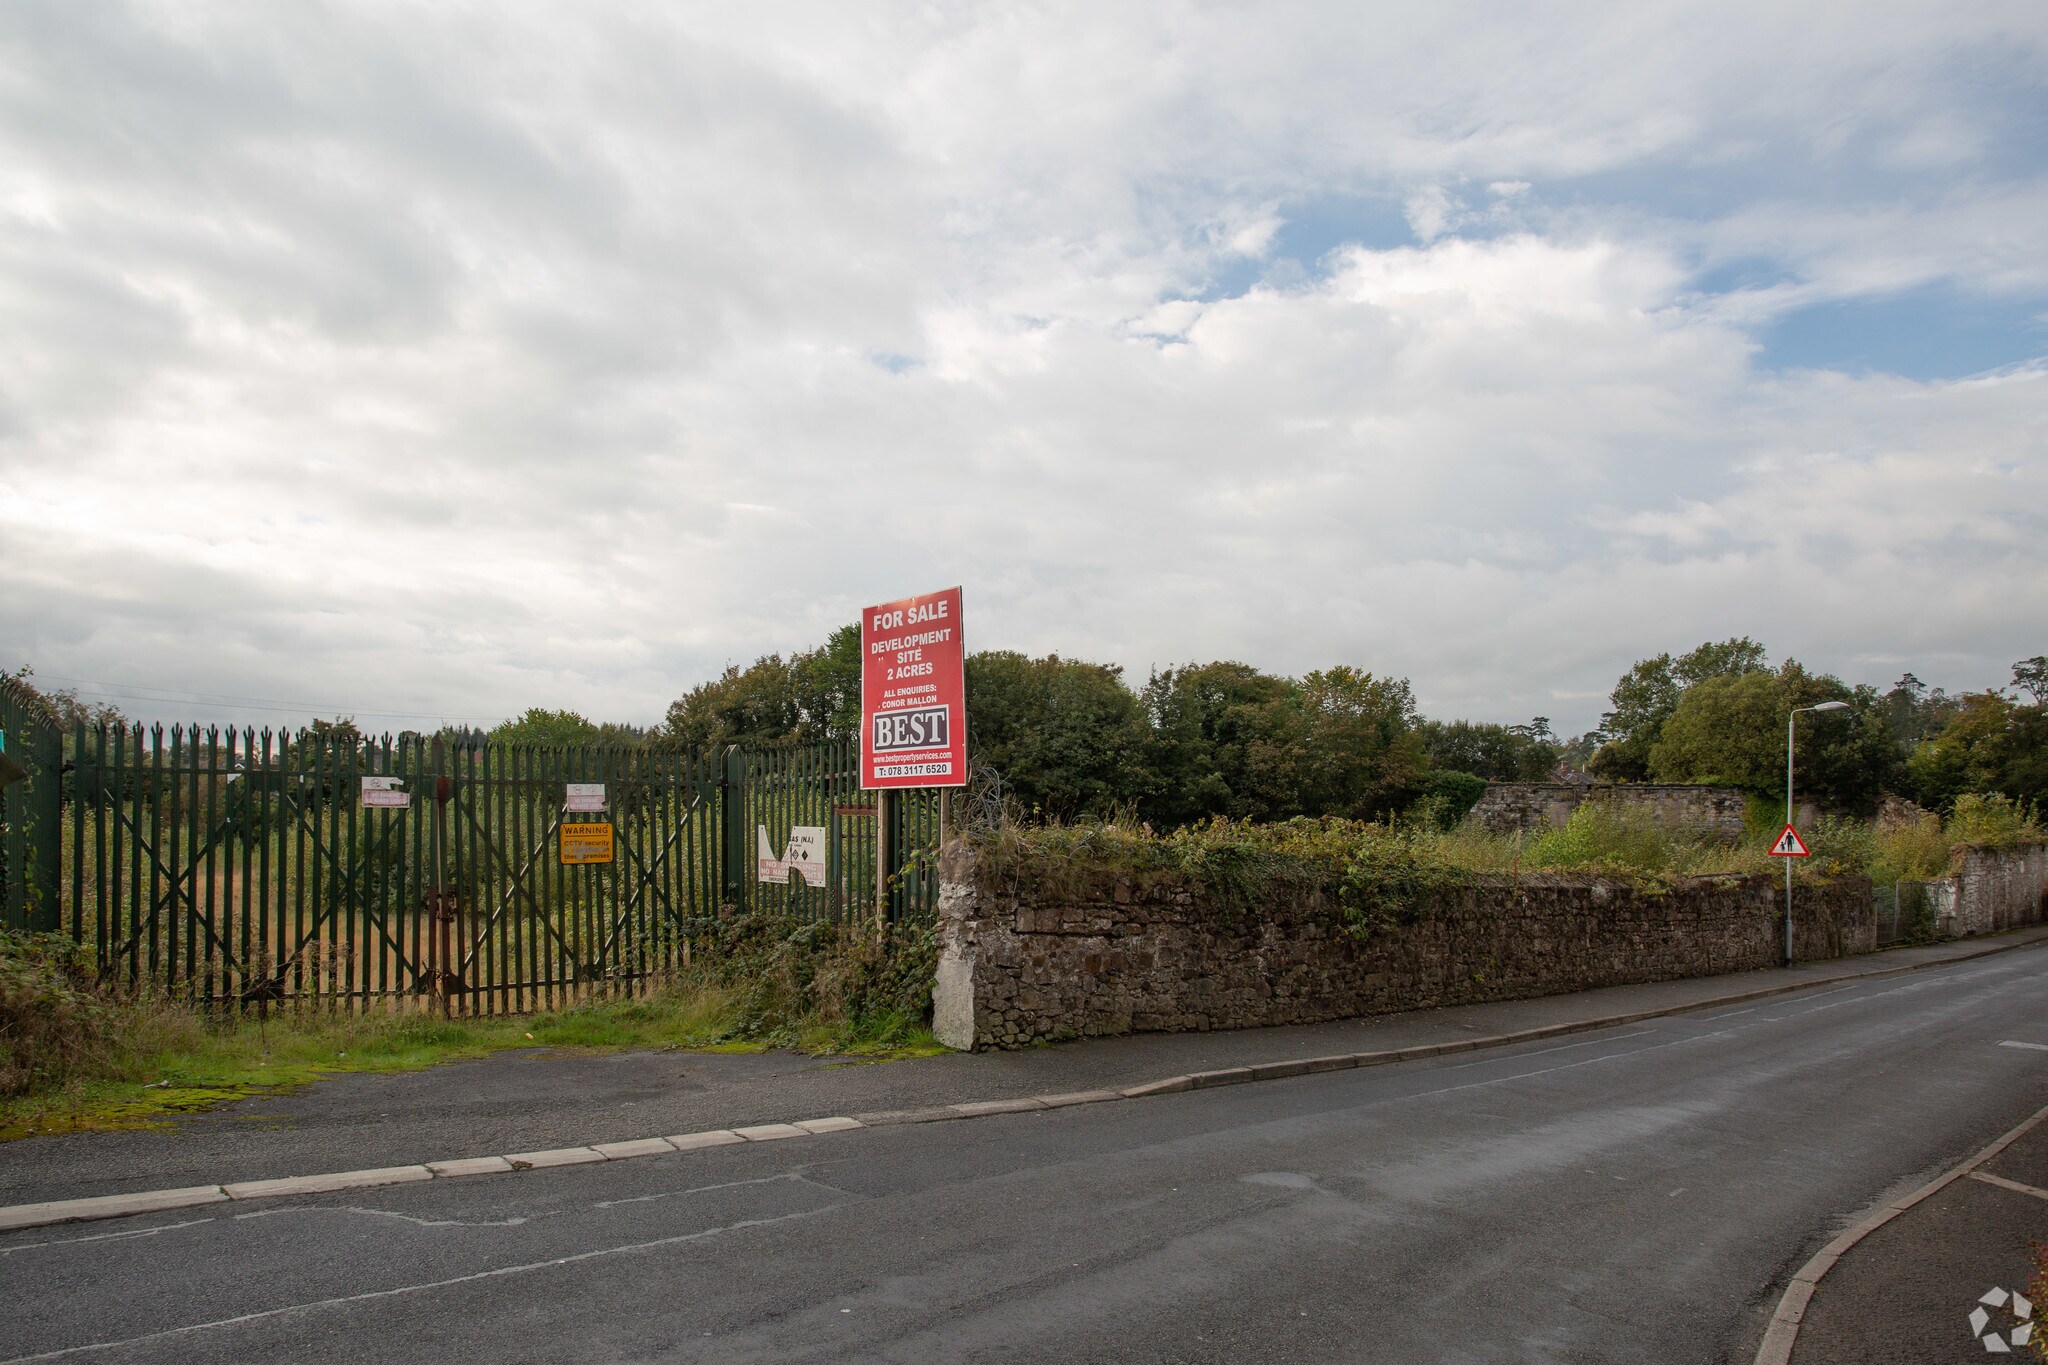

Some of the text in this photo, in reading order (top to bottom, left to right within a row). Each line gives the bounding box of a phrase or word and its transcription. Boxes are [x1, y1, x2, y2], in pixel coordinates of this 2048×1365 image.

[873, 600, 948, 632] FOR SALE
[871, 628, 951, 655] DEVELOPMENT
[897, 649, 922, 664] SITE
[887, 662, 933, 680] 2 ACRES
[883, 684, 937, 698] ALL ENQUIRIES:
[882, 695, 937, 709] CONOR MALLON
[876, 711, 945, 747] BEST
[873, 751, 952, 763] www.bestpropertyservices.com
[879, 763, 947, 776] T: 078 3117 6520
[564, 826, 608, 834] WARNING
[760, 867, 769, 875] NO
[804, 871, 822, 879] GHTS
